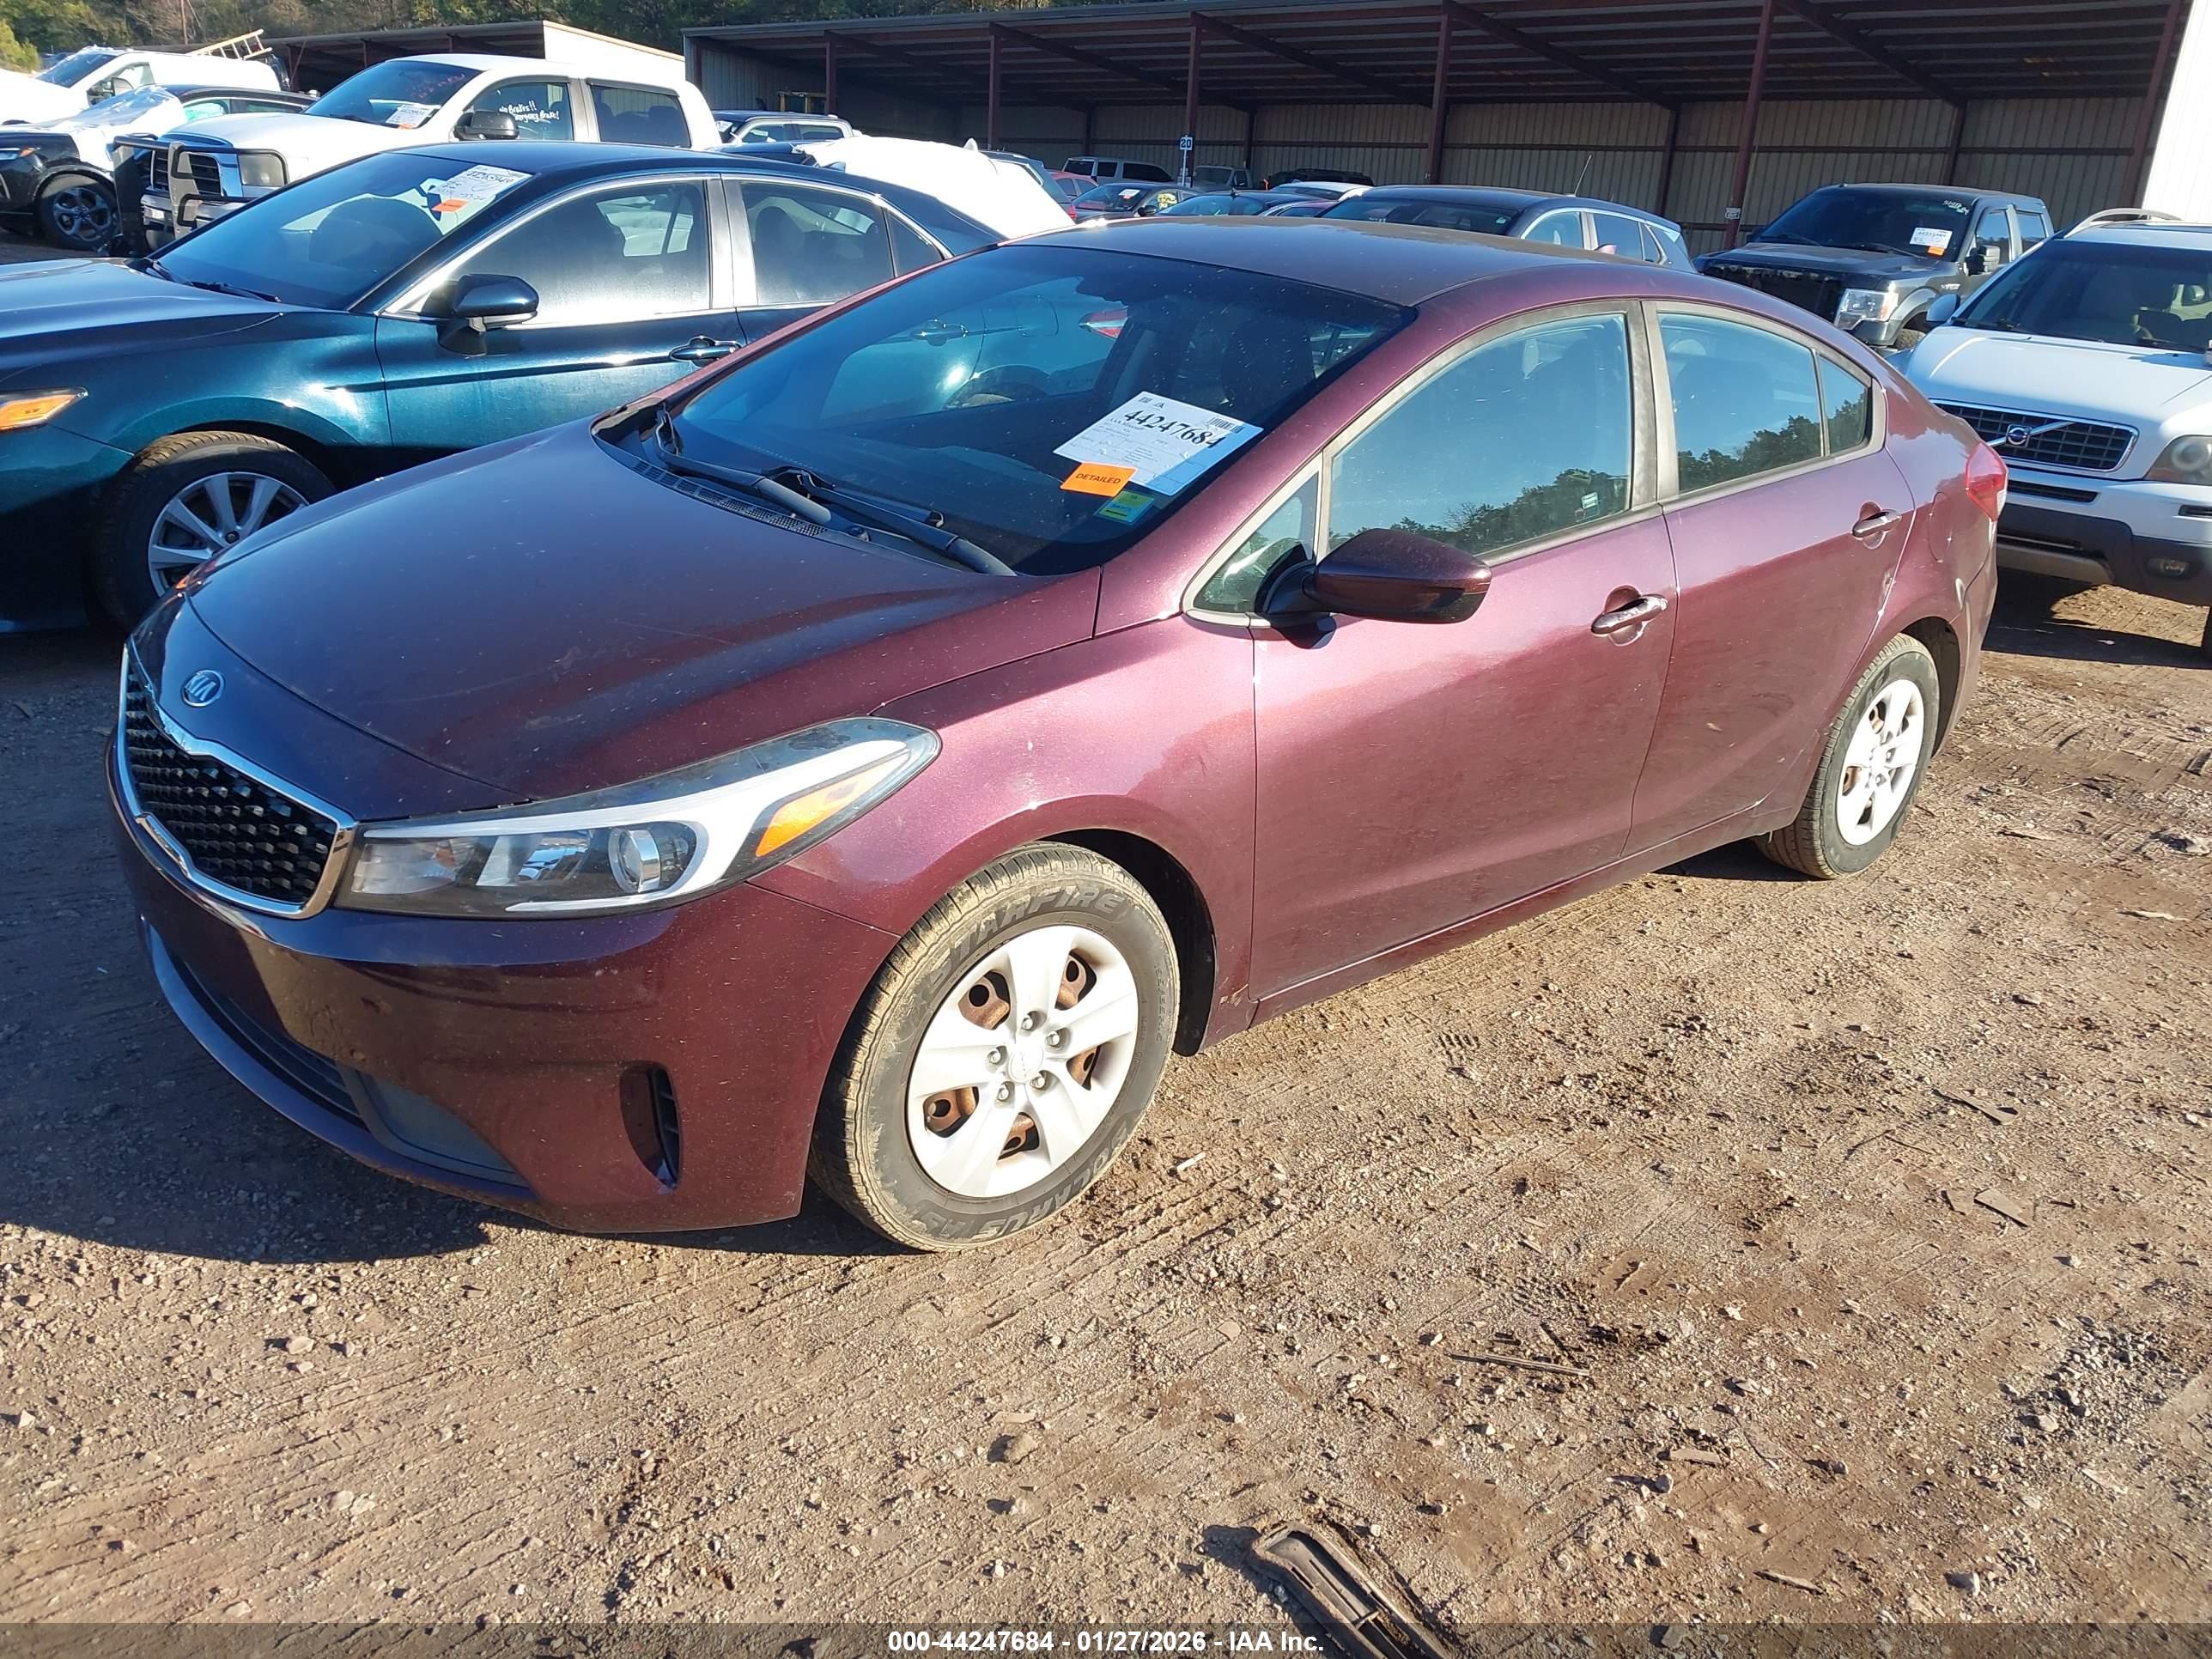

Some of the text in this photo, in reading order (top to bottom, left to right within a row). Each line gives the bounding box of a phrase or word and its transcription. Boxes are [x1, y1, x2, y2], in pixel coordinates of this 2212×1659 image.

[1181, 138, 1192, 149] 20
[1124, 410, 1227, 448] 44247684
[1075, 472, 1121, 485] DETAILED
[929, 885, 1124, 988] STARFIRE
